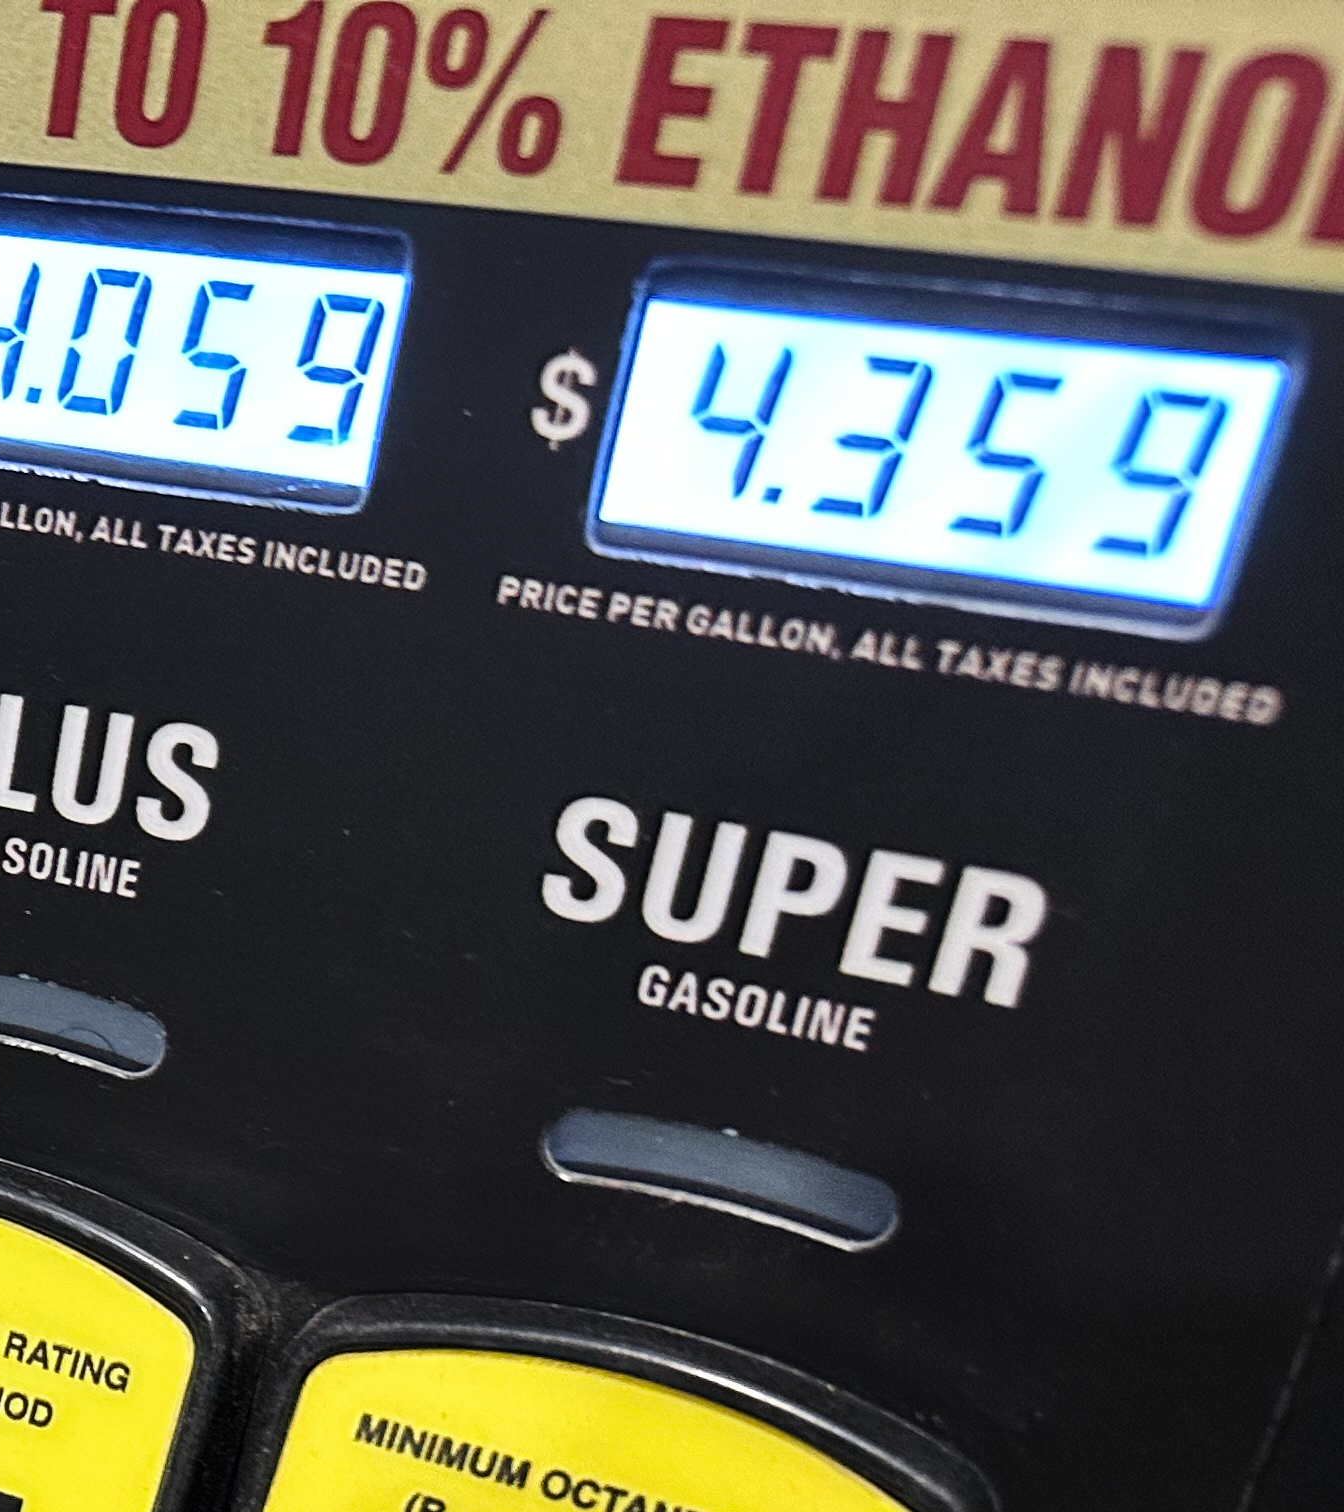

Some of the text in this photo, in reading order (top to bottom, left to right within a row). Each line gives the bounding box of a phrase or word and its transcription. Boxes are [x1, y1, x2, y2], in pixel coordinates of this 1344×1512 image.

[41, 0, 207, 148] TO
[265, 0, 562, 176] 10%
[530, 347, 598, 451] $
[689, 341, 1230, 558] 4.359
[90, 515, 148, 551] ALL
[157, 523, 257, 567] TAXES
[262, 539, 428, 592] INCLUDED
[496, 574, 604, 621] PRICE
[606, 592, 679, 634] PER
[850, 628, 925, 673] ALL
[934, 638, 1064, 695] TAXES
[1068, 661, 1285, 728] INCLUDED
[539, 795, 1050, 1010] SUPER
[636, 963, 878, 1054] GASOLINE
[3, 1331, 132, 1393] RATING
[353, 1412, 531, 1490] MINIMUM
